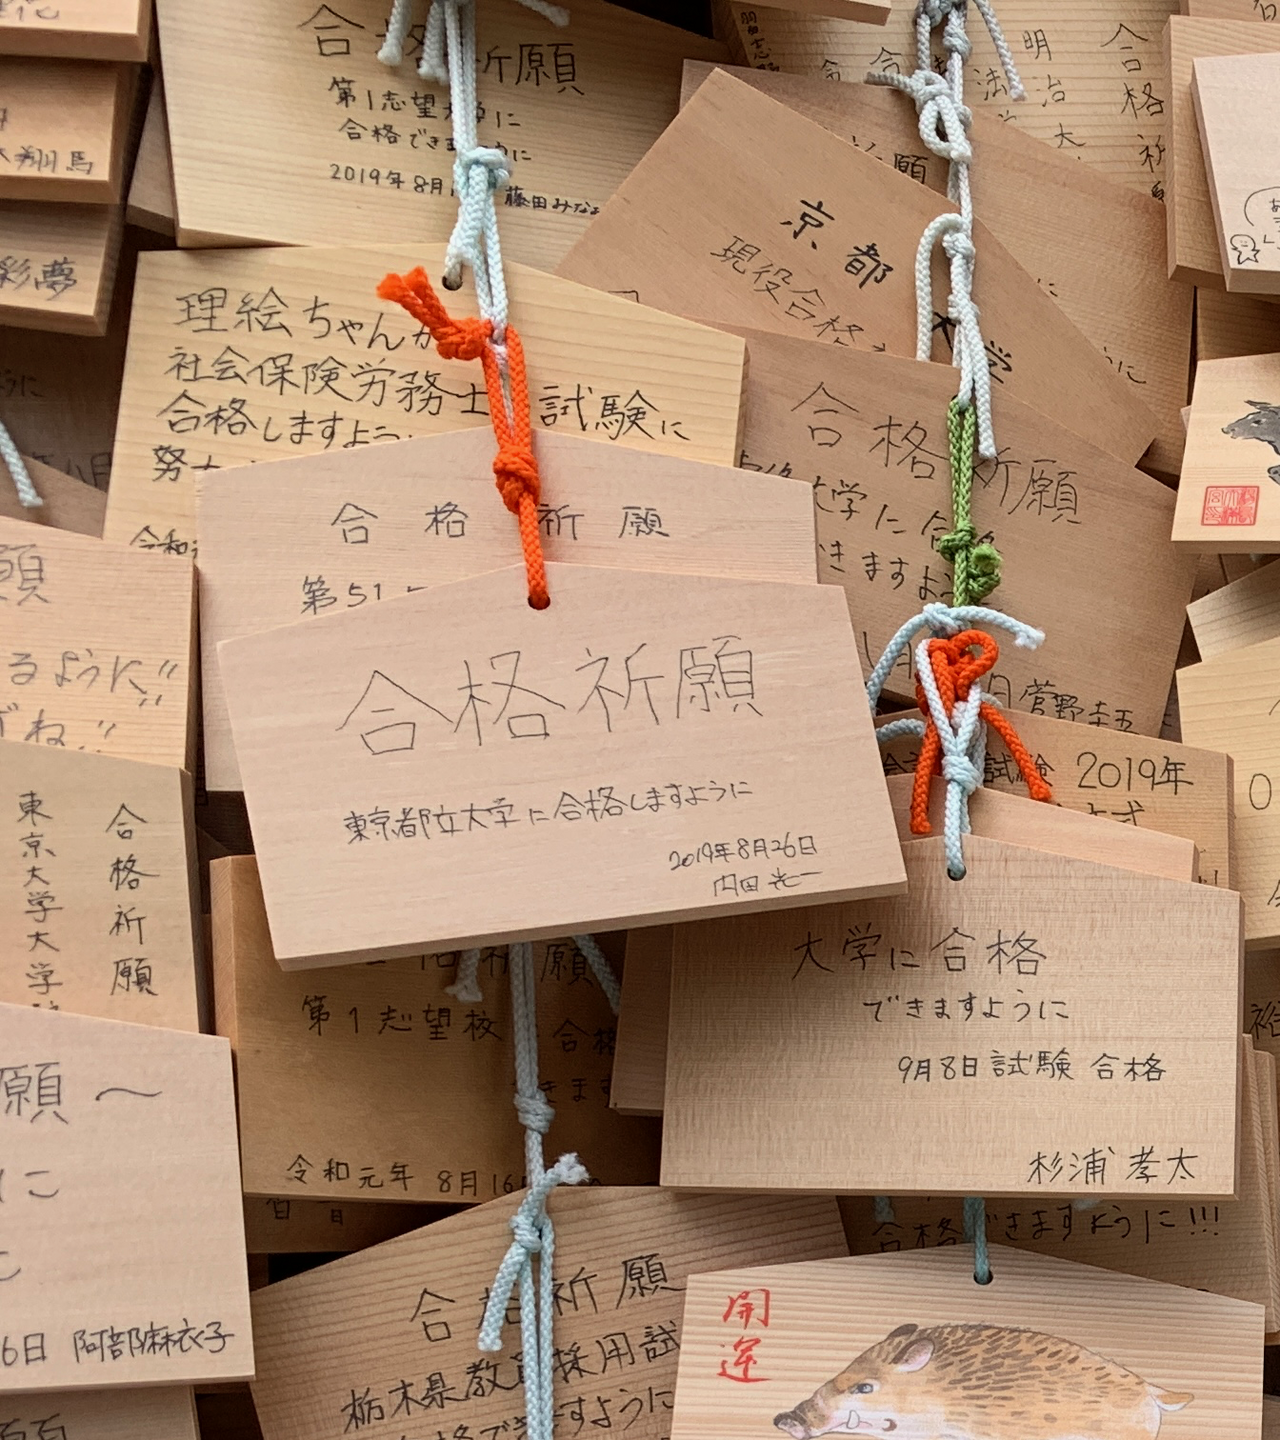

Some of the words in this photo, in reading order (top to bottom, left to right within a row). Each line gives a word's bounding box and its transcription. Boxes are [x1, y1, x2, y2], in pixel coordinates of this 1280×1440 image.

[331, 502, 670, 546] 合格祈願
[335, 634, 763, 755] 合格祈願
[343, 781, 753, 845] 東京都立大学に合格しますように
[669, 834, 818, 871] 2019年8月26日
[17, 791, 64, 1009] 東京大学大学
[105, 803, 160, 996] 合格祈願
[792, 921, 1048, 980] 大学に合格
[862, 991, 1070, 1023] できますように
[717, 1287, 772, 1384] 開運
